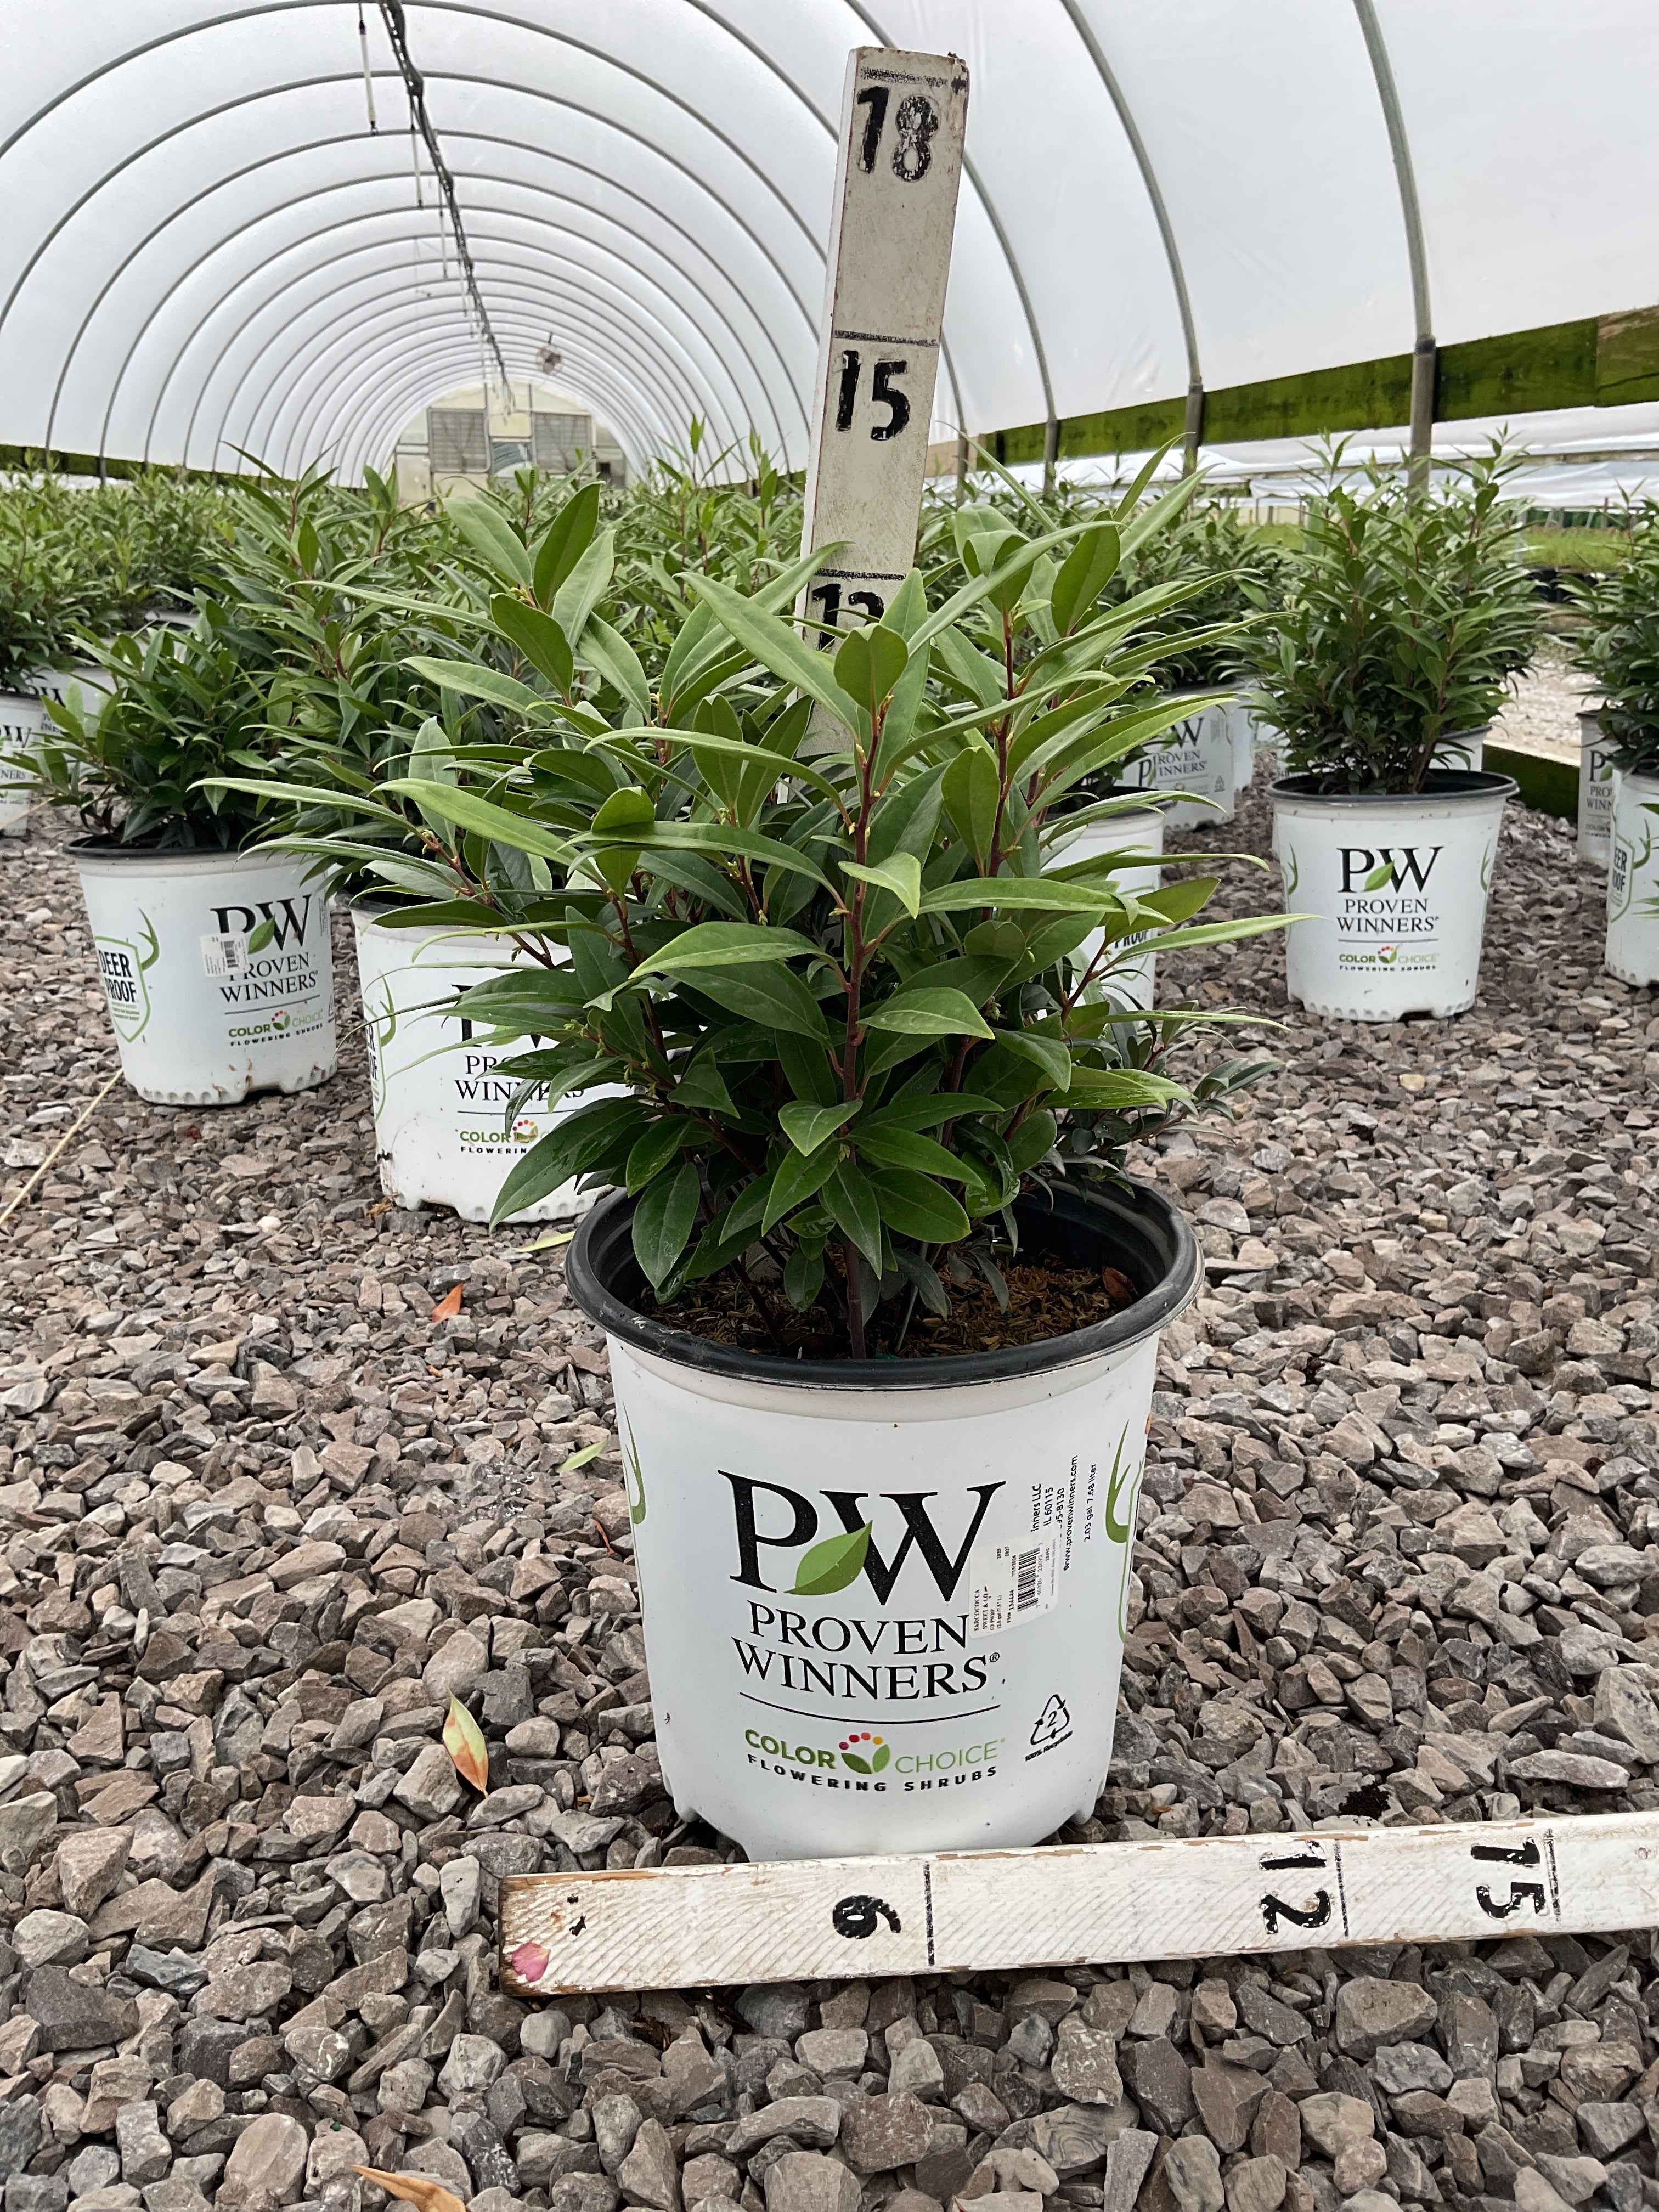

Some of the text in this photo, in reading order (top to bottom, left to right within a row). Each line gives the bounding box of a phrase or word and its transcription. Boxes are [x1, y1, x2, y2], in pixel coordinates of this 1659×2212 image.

[857, 86, 939, 182] 18
[836, 350, 911, 441] 15
[1157, 749, 1200, 765] ROVEN
[1159, 762, 1205, 776] INNERS
[1336, 845, 1444, 894] PW
[1344, 898, 1429, 914] PROVEN
[98, 949, 133, 978] DEER
[230, 952, 310, 981] ROVEN
[1339, 953, 1376, 964] COLOR
[228, 1012, 322, 1037] COLOR CHOICE
[230, 1032, 291, 1047] FLOWERING
[460, 1130, 511, 1143] COLOR
[461, 1146, 527, 1154] FLOWERIN
[1032, 1483, 1042, 1502] LLC
[1044, 1487, 1054, 1516] 60115
[1084, 1522, 1092, 1542] 2.03
[1088, 1464, 1097, 1483] liter
[1063, 1455, 1078, 1571] www.provenwinners.com
[717, 1470, 1006, 1606] PW
[746, 1600, 969, 1655] PROVEN
[1047, 1710, 1058, 1728] 2
[745, 1729, 999, 1774] COLOR CHOICE
[748, 1753, 997, 1792] FLOWERING SHRUBS
[1259, 1839, 1331, 1935] 12
[1470, 1837, 1546, 1920] 15
[832, 1895, 901, 1939] 6
